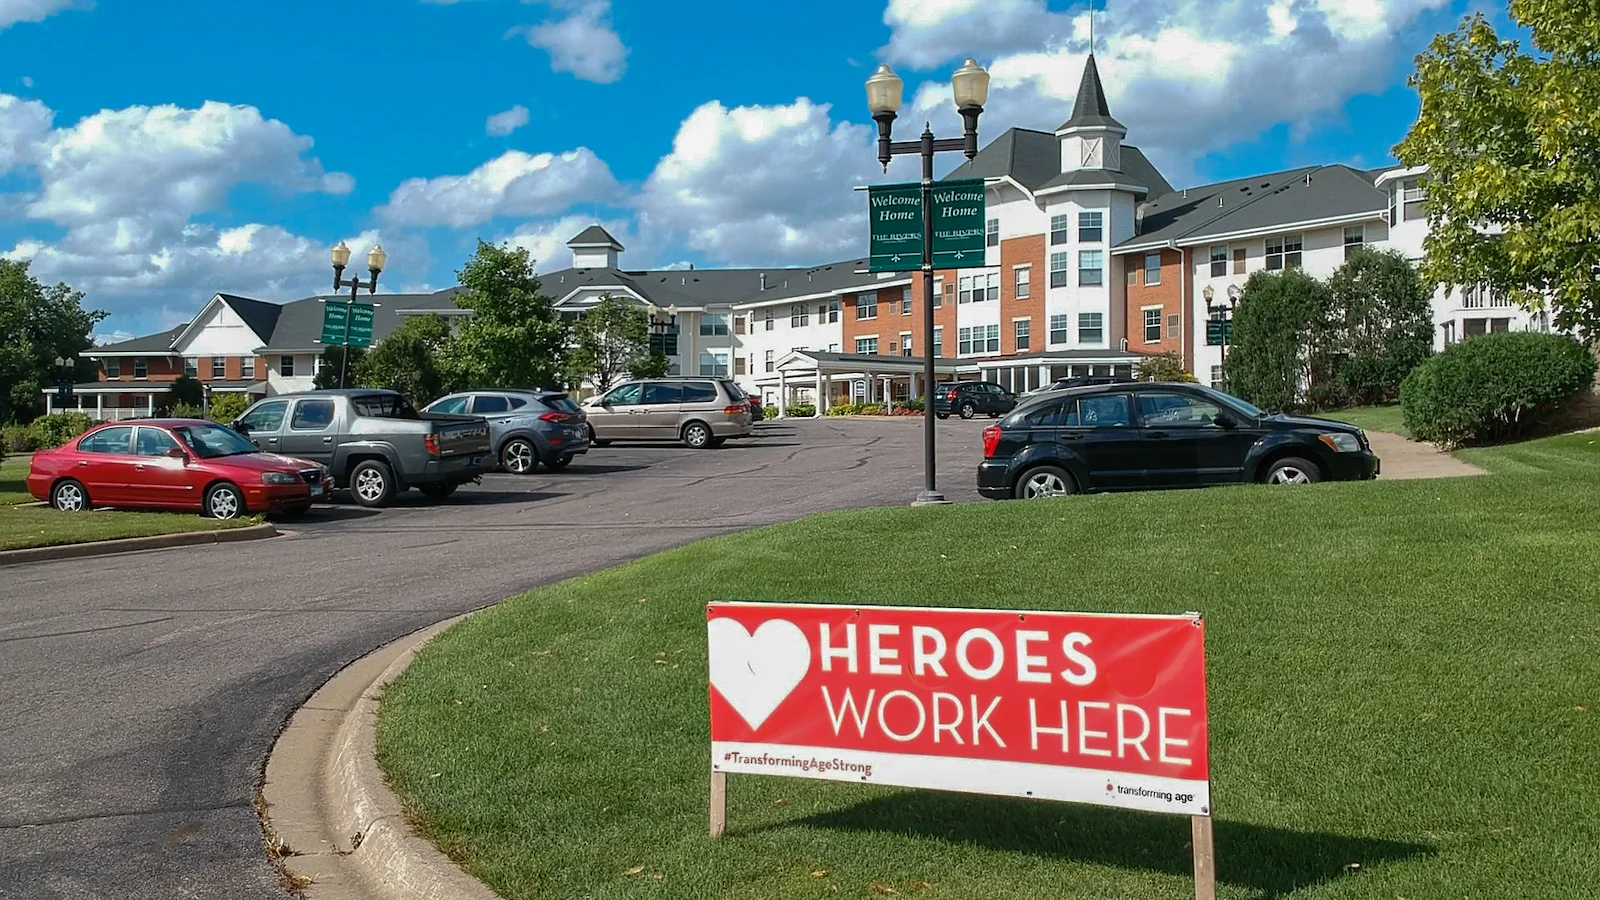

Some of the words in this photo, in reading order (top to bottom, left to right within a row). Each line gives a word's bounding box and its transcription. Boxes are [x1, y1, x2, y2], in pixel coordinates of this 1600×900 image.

[871, 194, 920, 207] Welcome
[933, 190, 983, 204] Welcome
[880, 211, 914, 221] Home
[941, 206, 978, 218] Home
[872, 233, 888, 241] THE
[889, 231, 922, 241] RIVERS
[935, 230, 951, 238] THE
[952, 227, 985, 237] RIVERS
[819, 622, 1097, 686] HEROES
[821, 686, 1007, 748] WORK
[1029, 697, 1193, 766] HERE
[724, 751, 872, 777] #TransformingAgeStrong
[1117, 785, 1172, 803] transforming
[1174, 792, 1194, 804] age
